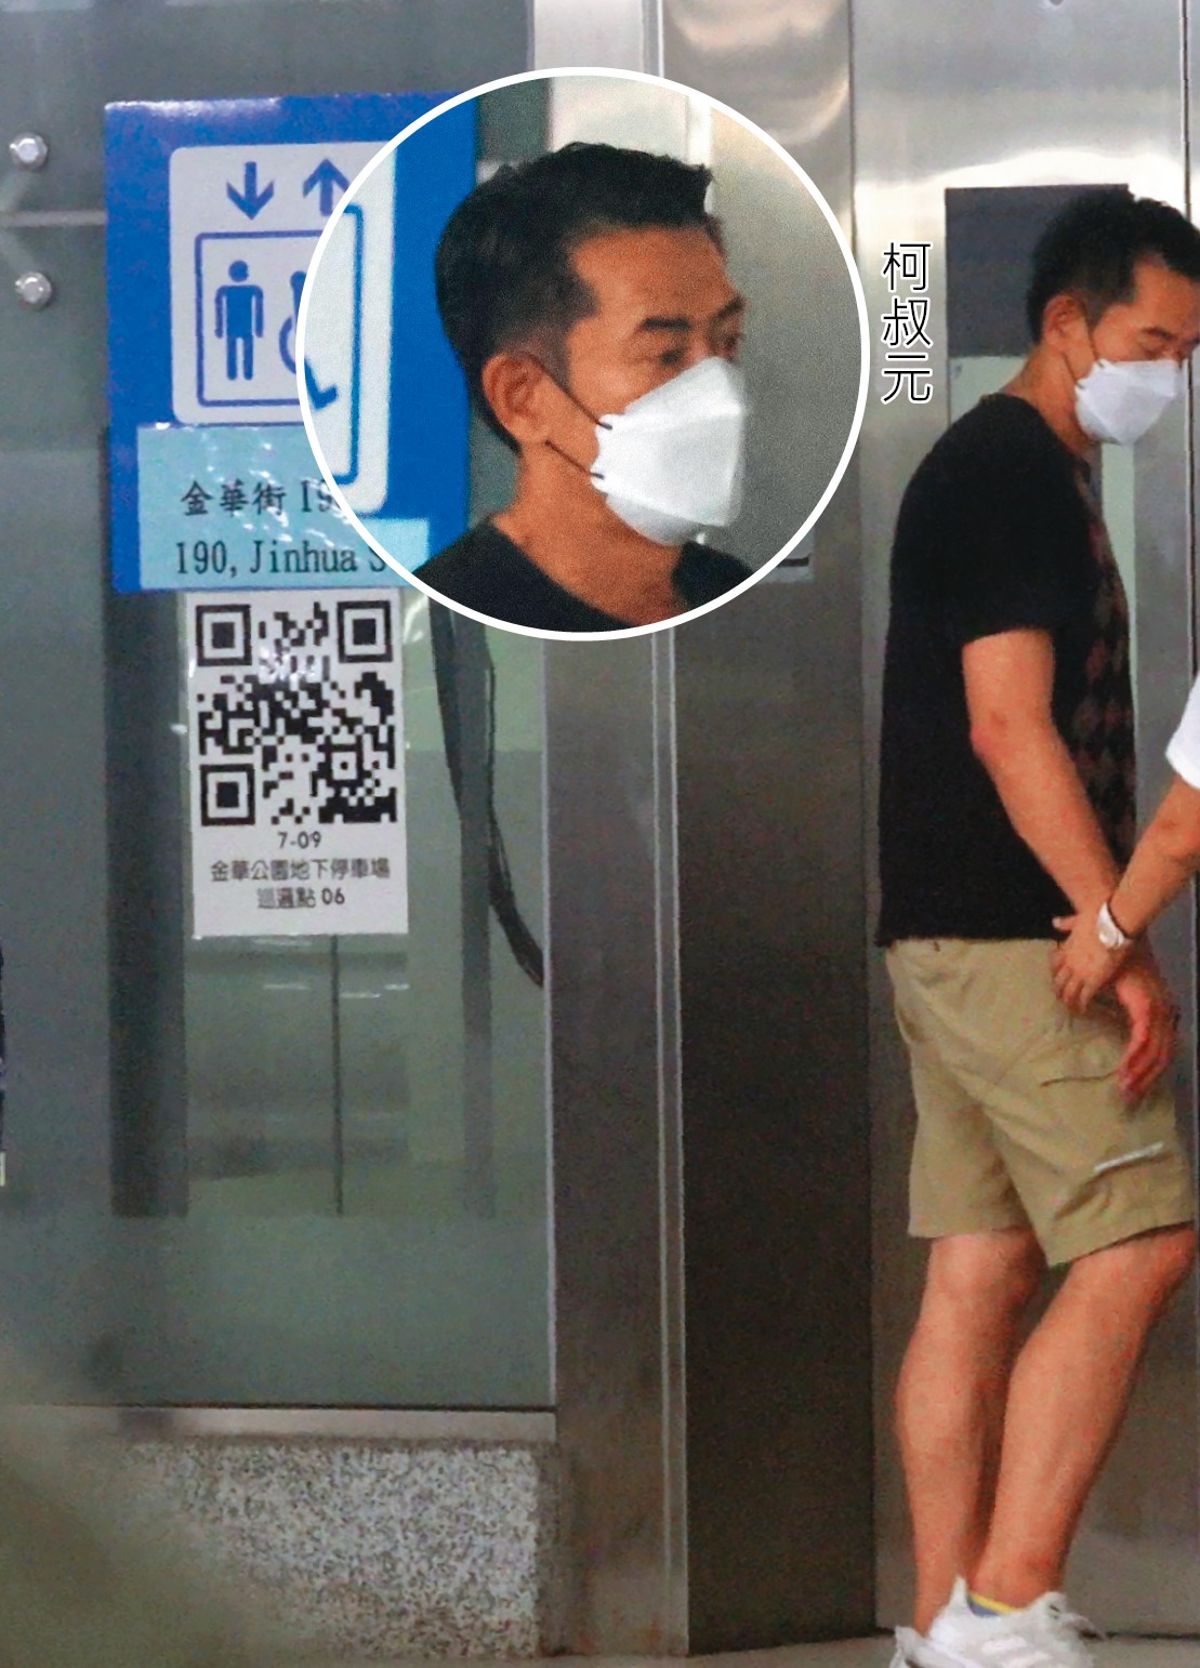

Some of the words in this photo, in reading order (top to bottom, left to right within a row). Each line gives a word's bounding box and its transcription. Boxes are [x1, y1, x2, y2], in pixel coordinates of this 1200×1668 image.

[180, 479, 287, 516] 金華街
[301, 479, 341, 512] 19
[176, 540, 238, 577] 190,
[250, 539, 358, 574] Jinhua
[277, 831, 322, 849] 7-09
[210, 857, 391, 882] 金華公園地下停車場
[321, 887, 346, 906] 06
